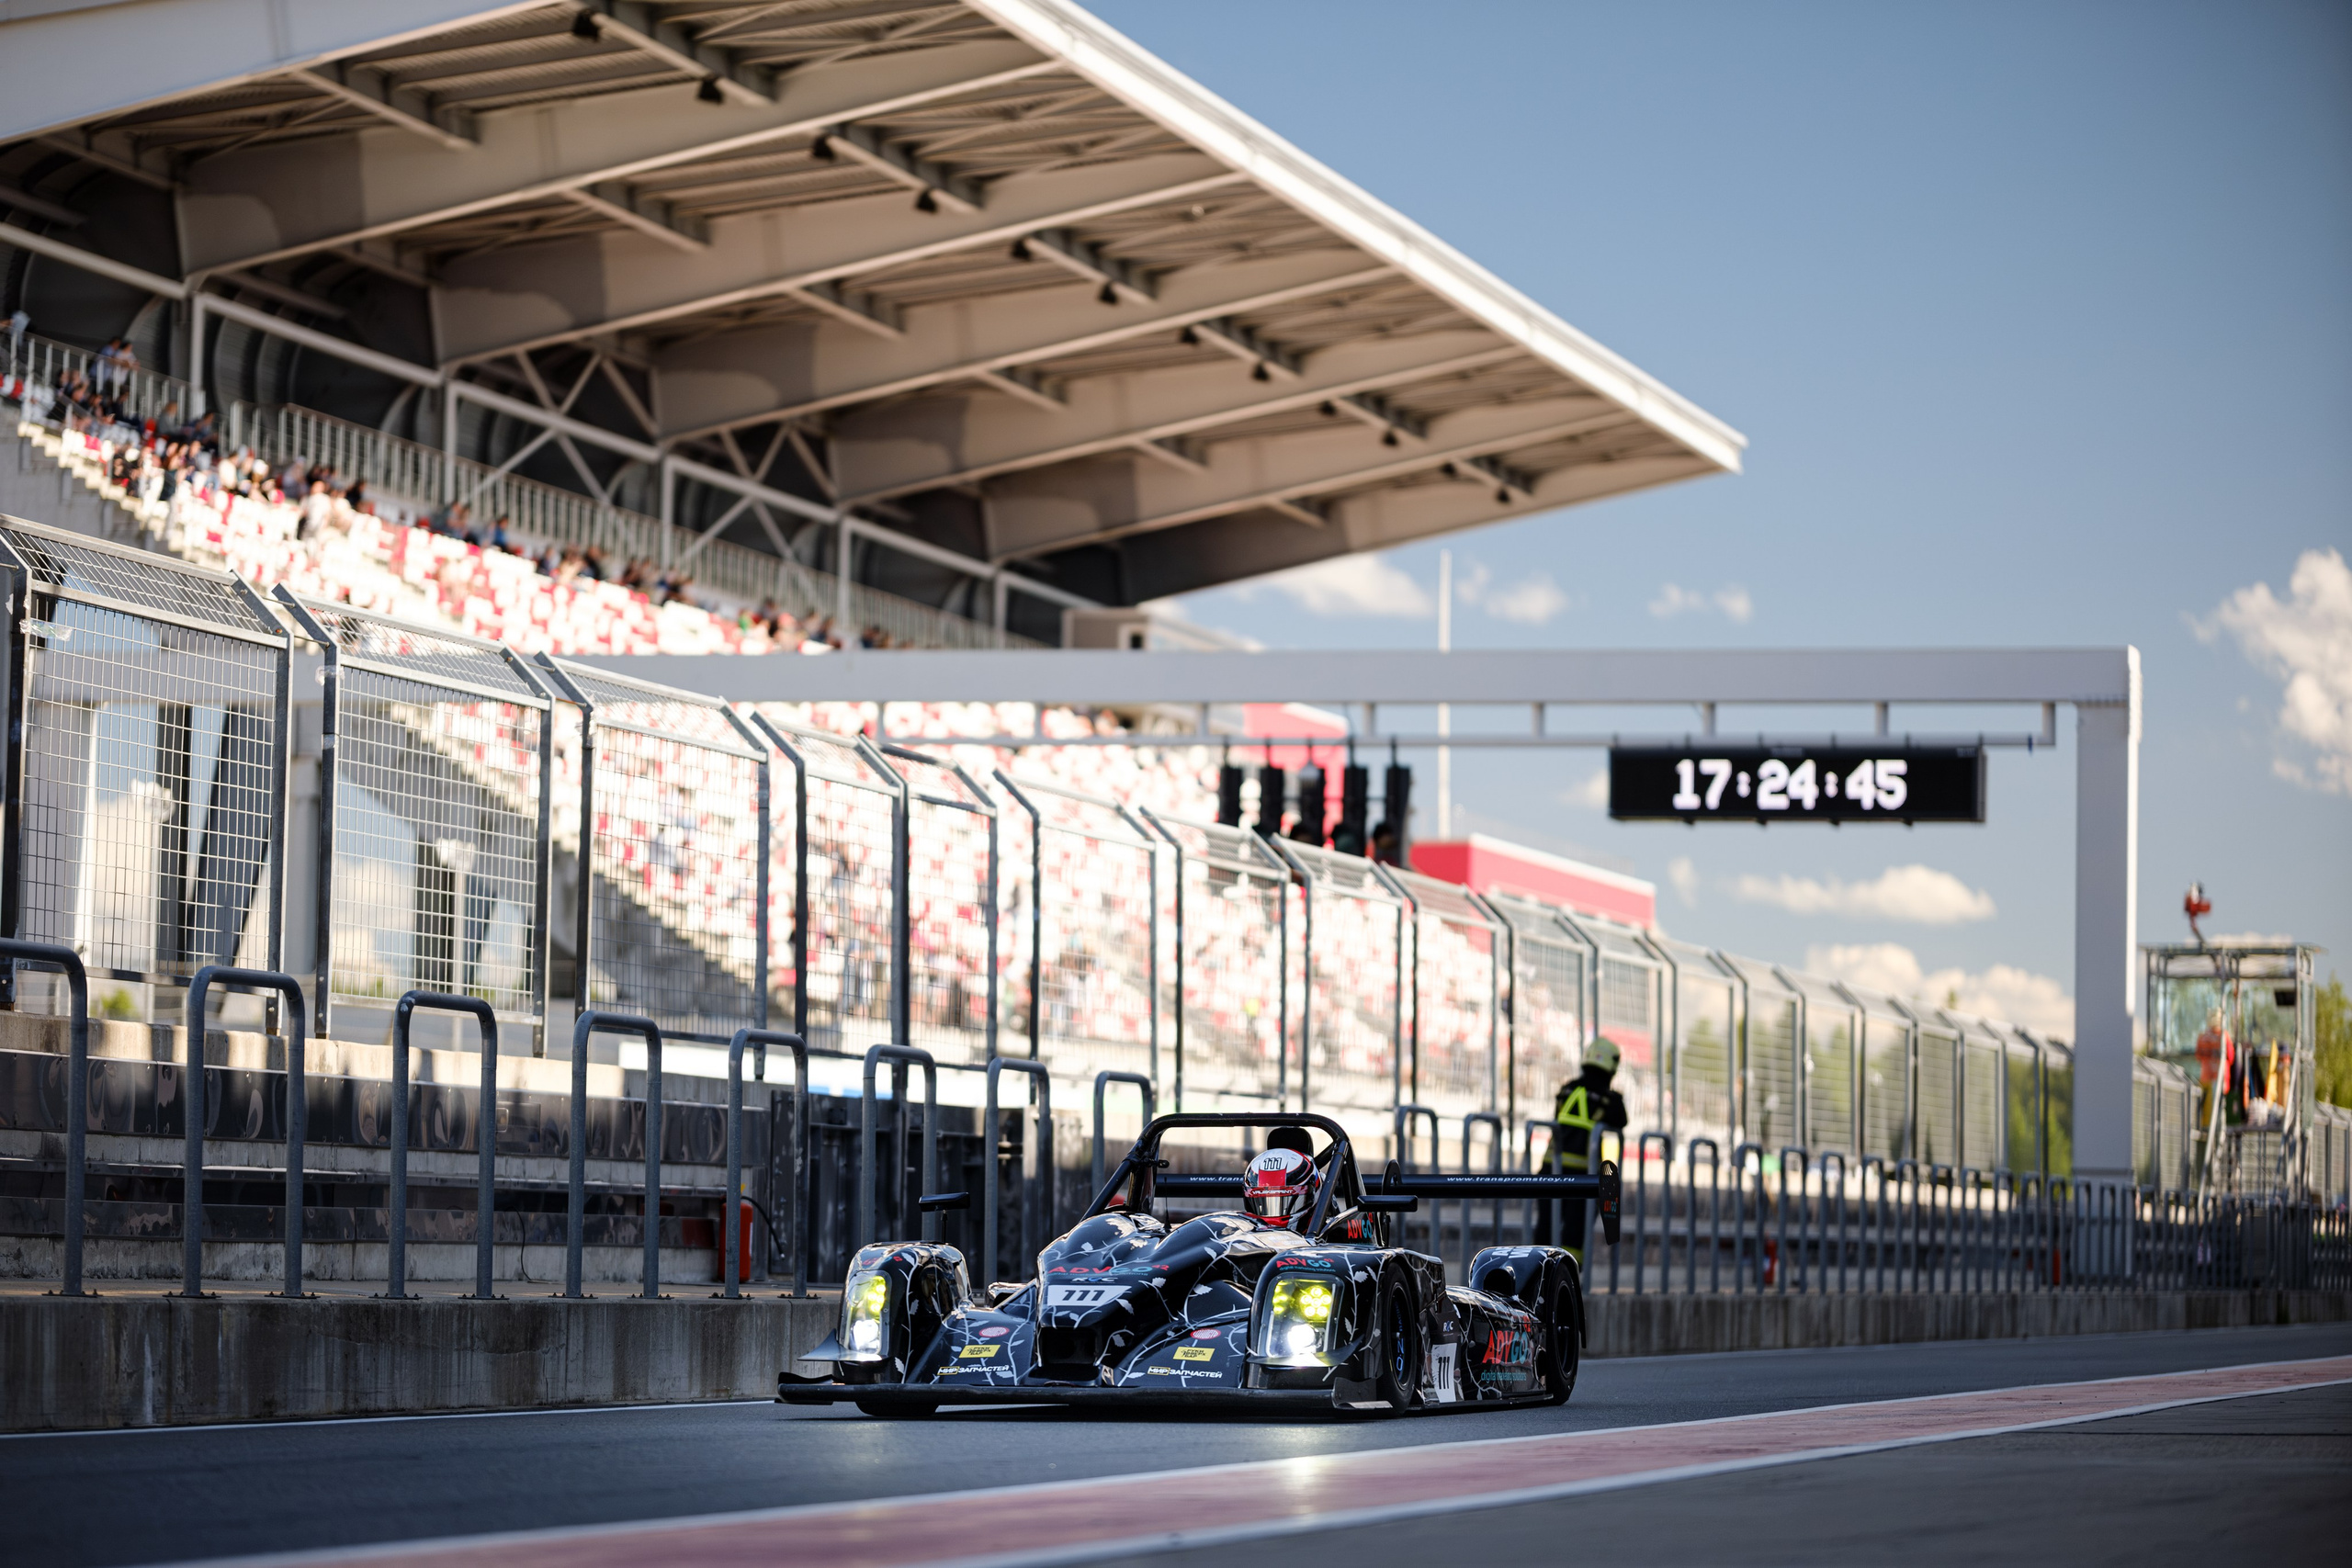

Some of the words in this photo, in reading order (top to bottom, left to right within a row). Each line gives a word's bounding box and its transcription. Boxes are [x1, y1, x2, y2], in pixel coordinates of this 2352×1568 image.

[1672, 759, 1908, 810] 17:24:45
[1263, 1156, 1283, 1170] 111
[1062, 1290, 1106, 1302] 111
[938, 1367, 957, 1375] МИР
[958, 1364, 1010, 1373] ЗАПЧАСТЕЙ
[1169, 1368, 1223, 1379] ЗАПЧАСТЕЙ
[1437, 1357, 1451, 1390] 111
